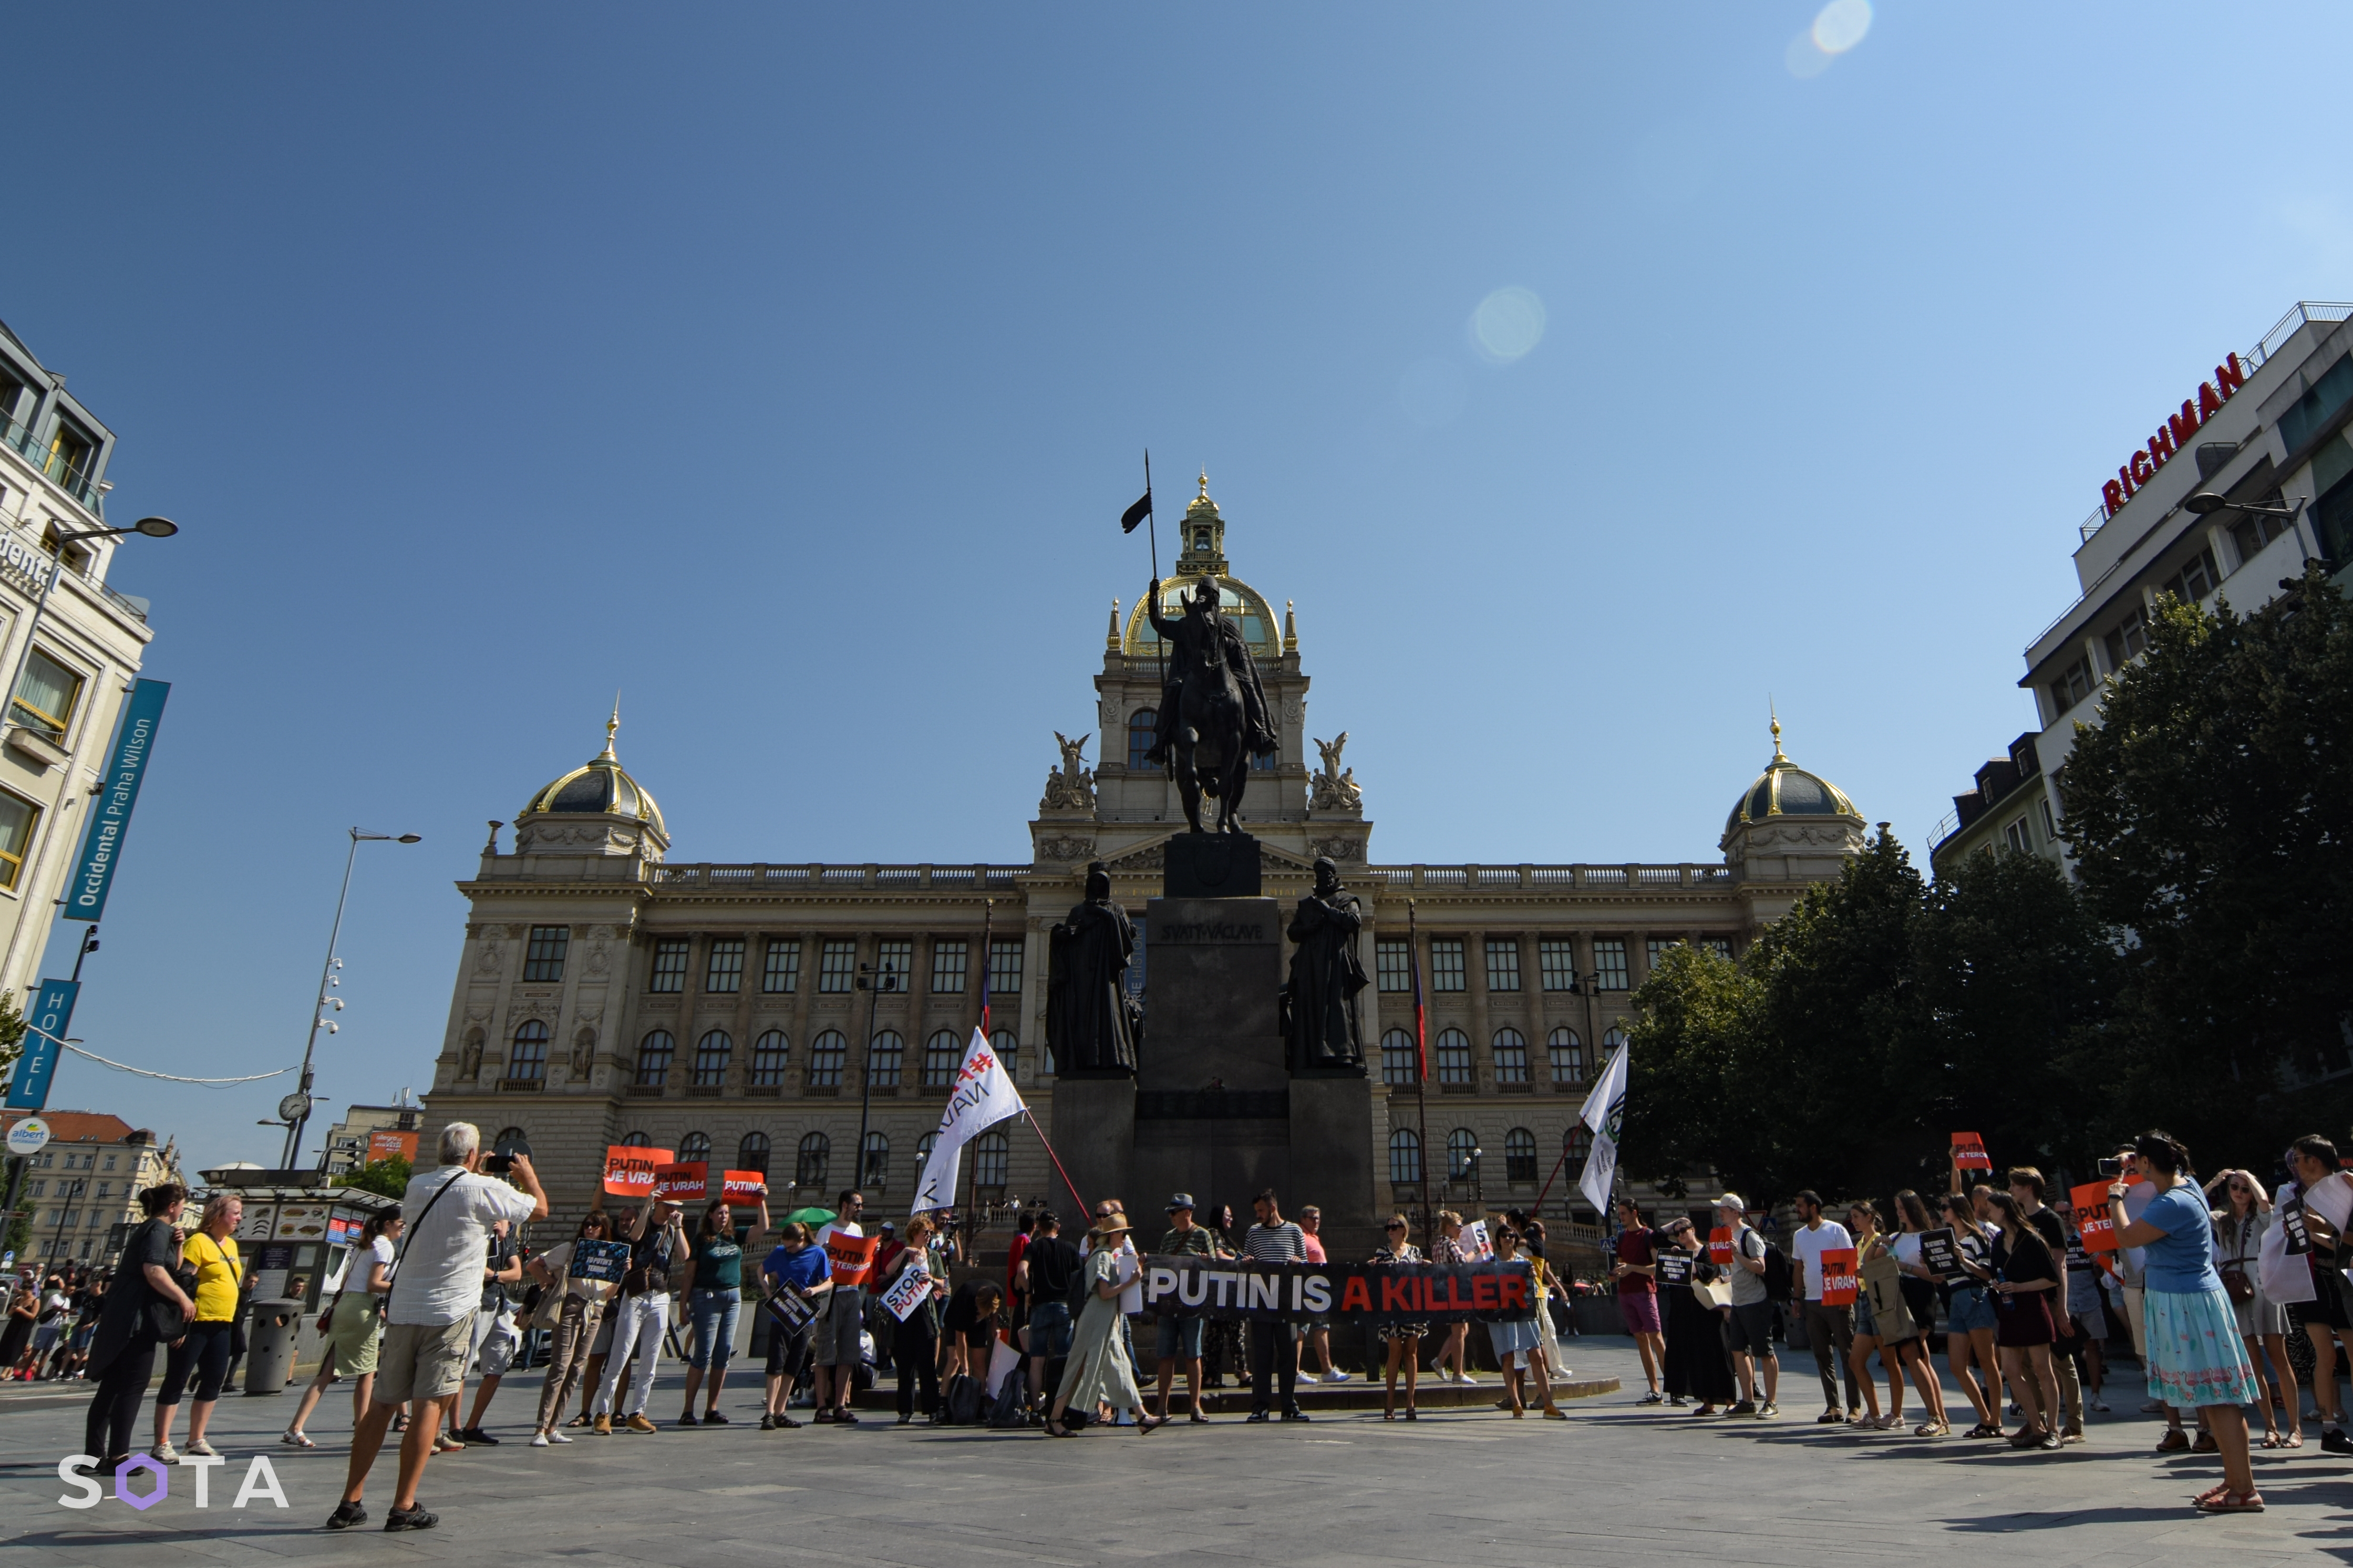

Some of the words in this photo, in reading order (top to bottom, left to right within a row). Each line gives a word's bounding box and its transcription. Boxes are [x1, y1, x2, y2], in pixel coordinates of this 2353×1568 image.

[2101, 351, 2245, 516] RICHMAN
[79, 821, 119, 906] Occidental
[107, 773, 134, 815] Praha
[121, 719, 151, 768] Wilson
[1132, 926, 1143, 978] HISTORY
[24, 993, 64, 1095] HOTEL
[12, 1129, 45, 1139] albert
[609, 1158, 653, 1171] PUTIN
[607, 1170, 626, 1182] JE
[628, 1171, 655, 1185] VRA
[657, 1172, 692, 1181] PUTIN
[672, 1181, 704, 1191] VRAH
[2078, 1202, 2111, 1222] PUT
[2083, 1221, 2095, 1233] JE
[825, 1247, 866, 1263] PUTIN
[1821, 1262, 1846, 1276] PUTIN
[887, 1269, 920, 1306] STOP
[1148, 1268, 1279, 1310] PUTIN
[1292, 1275, 1332, 1312] IS
[1341, 1276, 1373, 1311] A
[1381, 1274, 1528, 1311] KILLER
[1824, 1277, 1831, 1291] JE
[1831, 1275, 1856, 1290] VRAH
